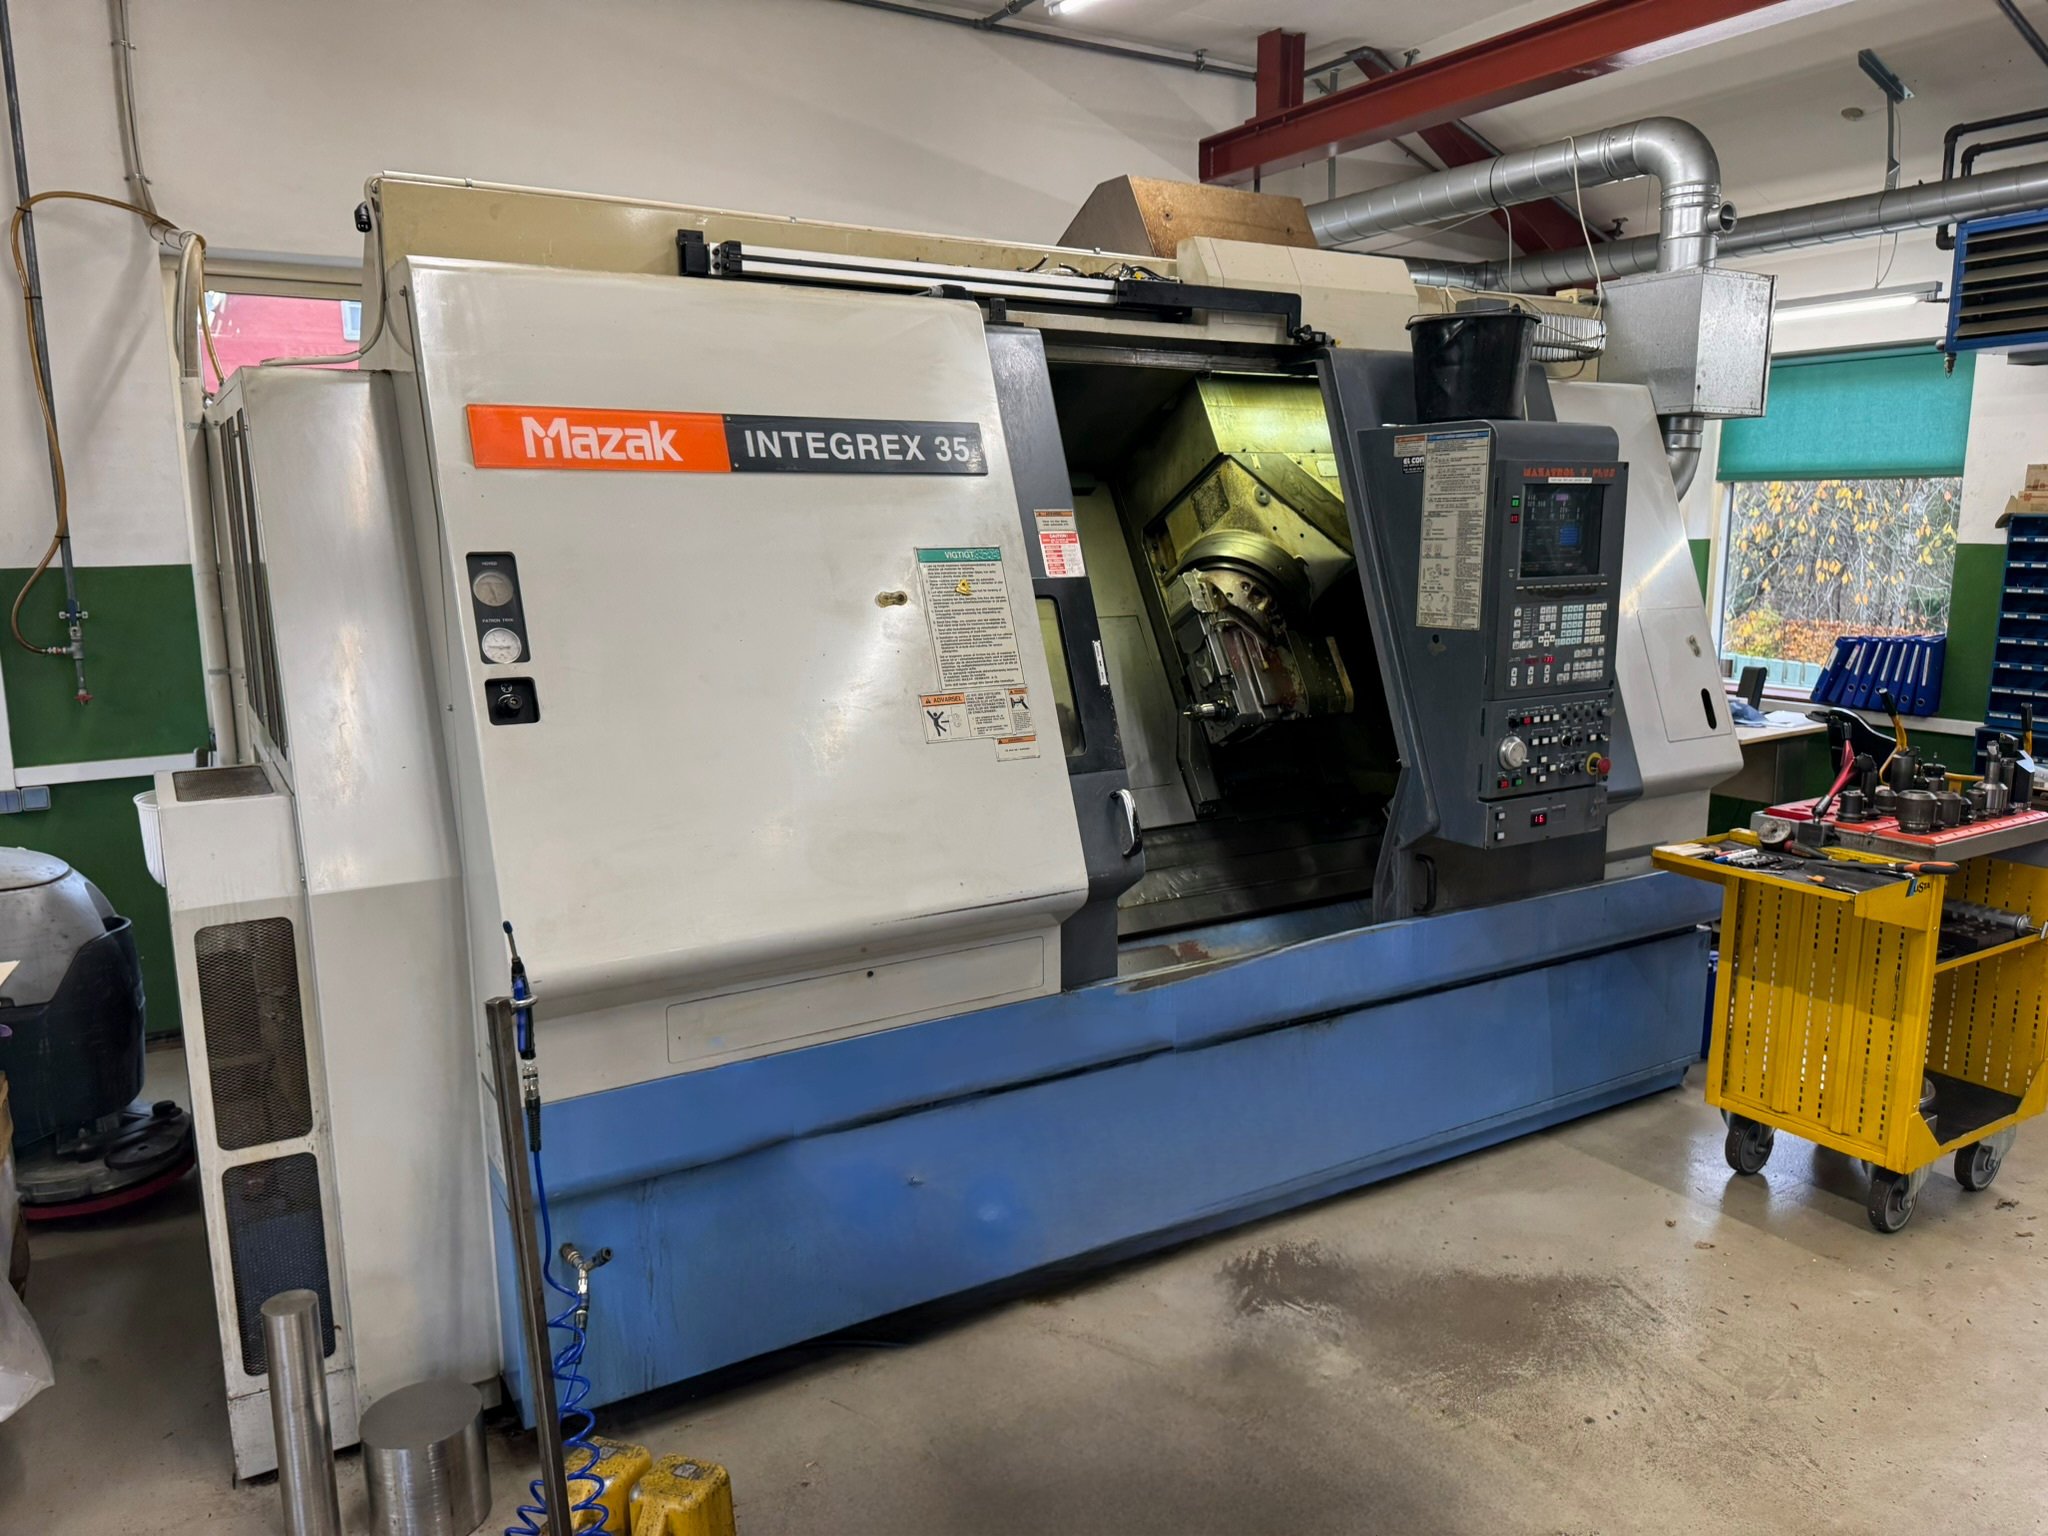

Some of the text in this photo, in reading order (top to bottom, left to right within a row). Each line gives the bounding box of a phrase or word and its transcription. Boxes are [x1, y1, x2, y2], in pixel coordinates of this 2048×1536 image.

[521, 417, 684, 461] Mazak
[745, 430, 970, 462] INTEGREX 35
[944, 551, 975, 560] VIGTIGT
[933, 696, 963, 704] ADVARSEL
